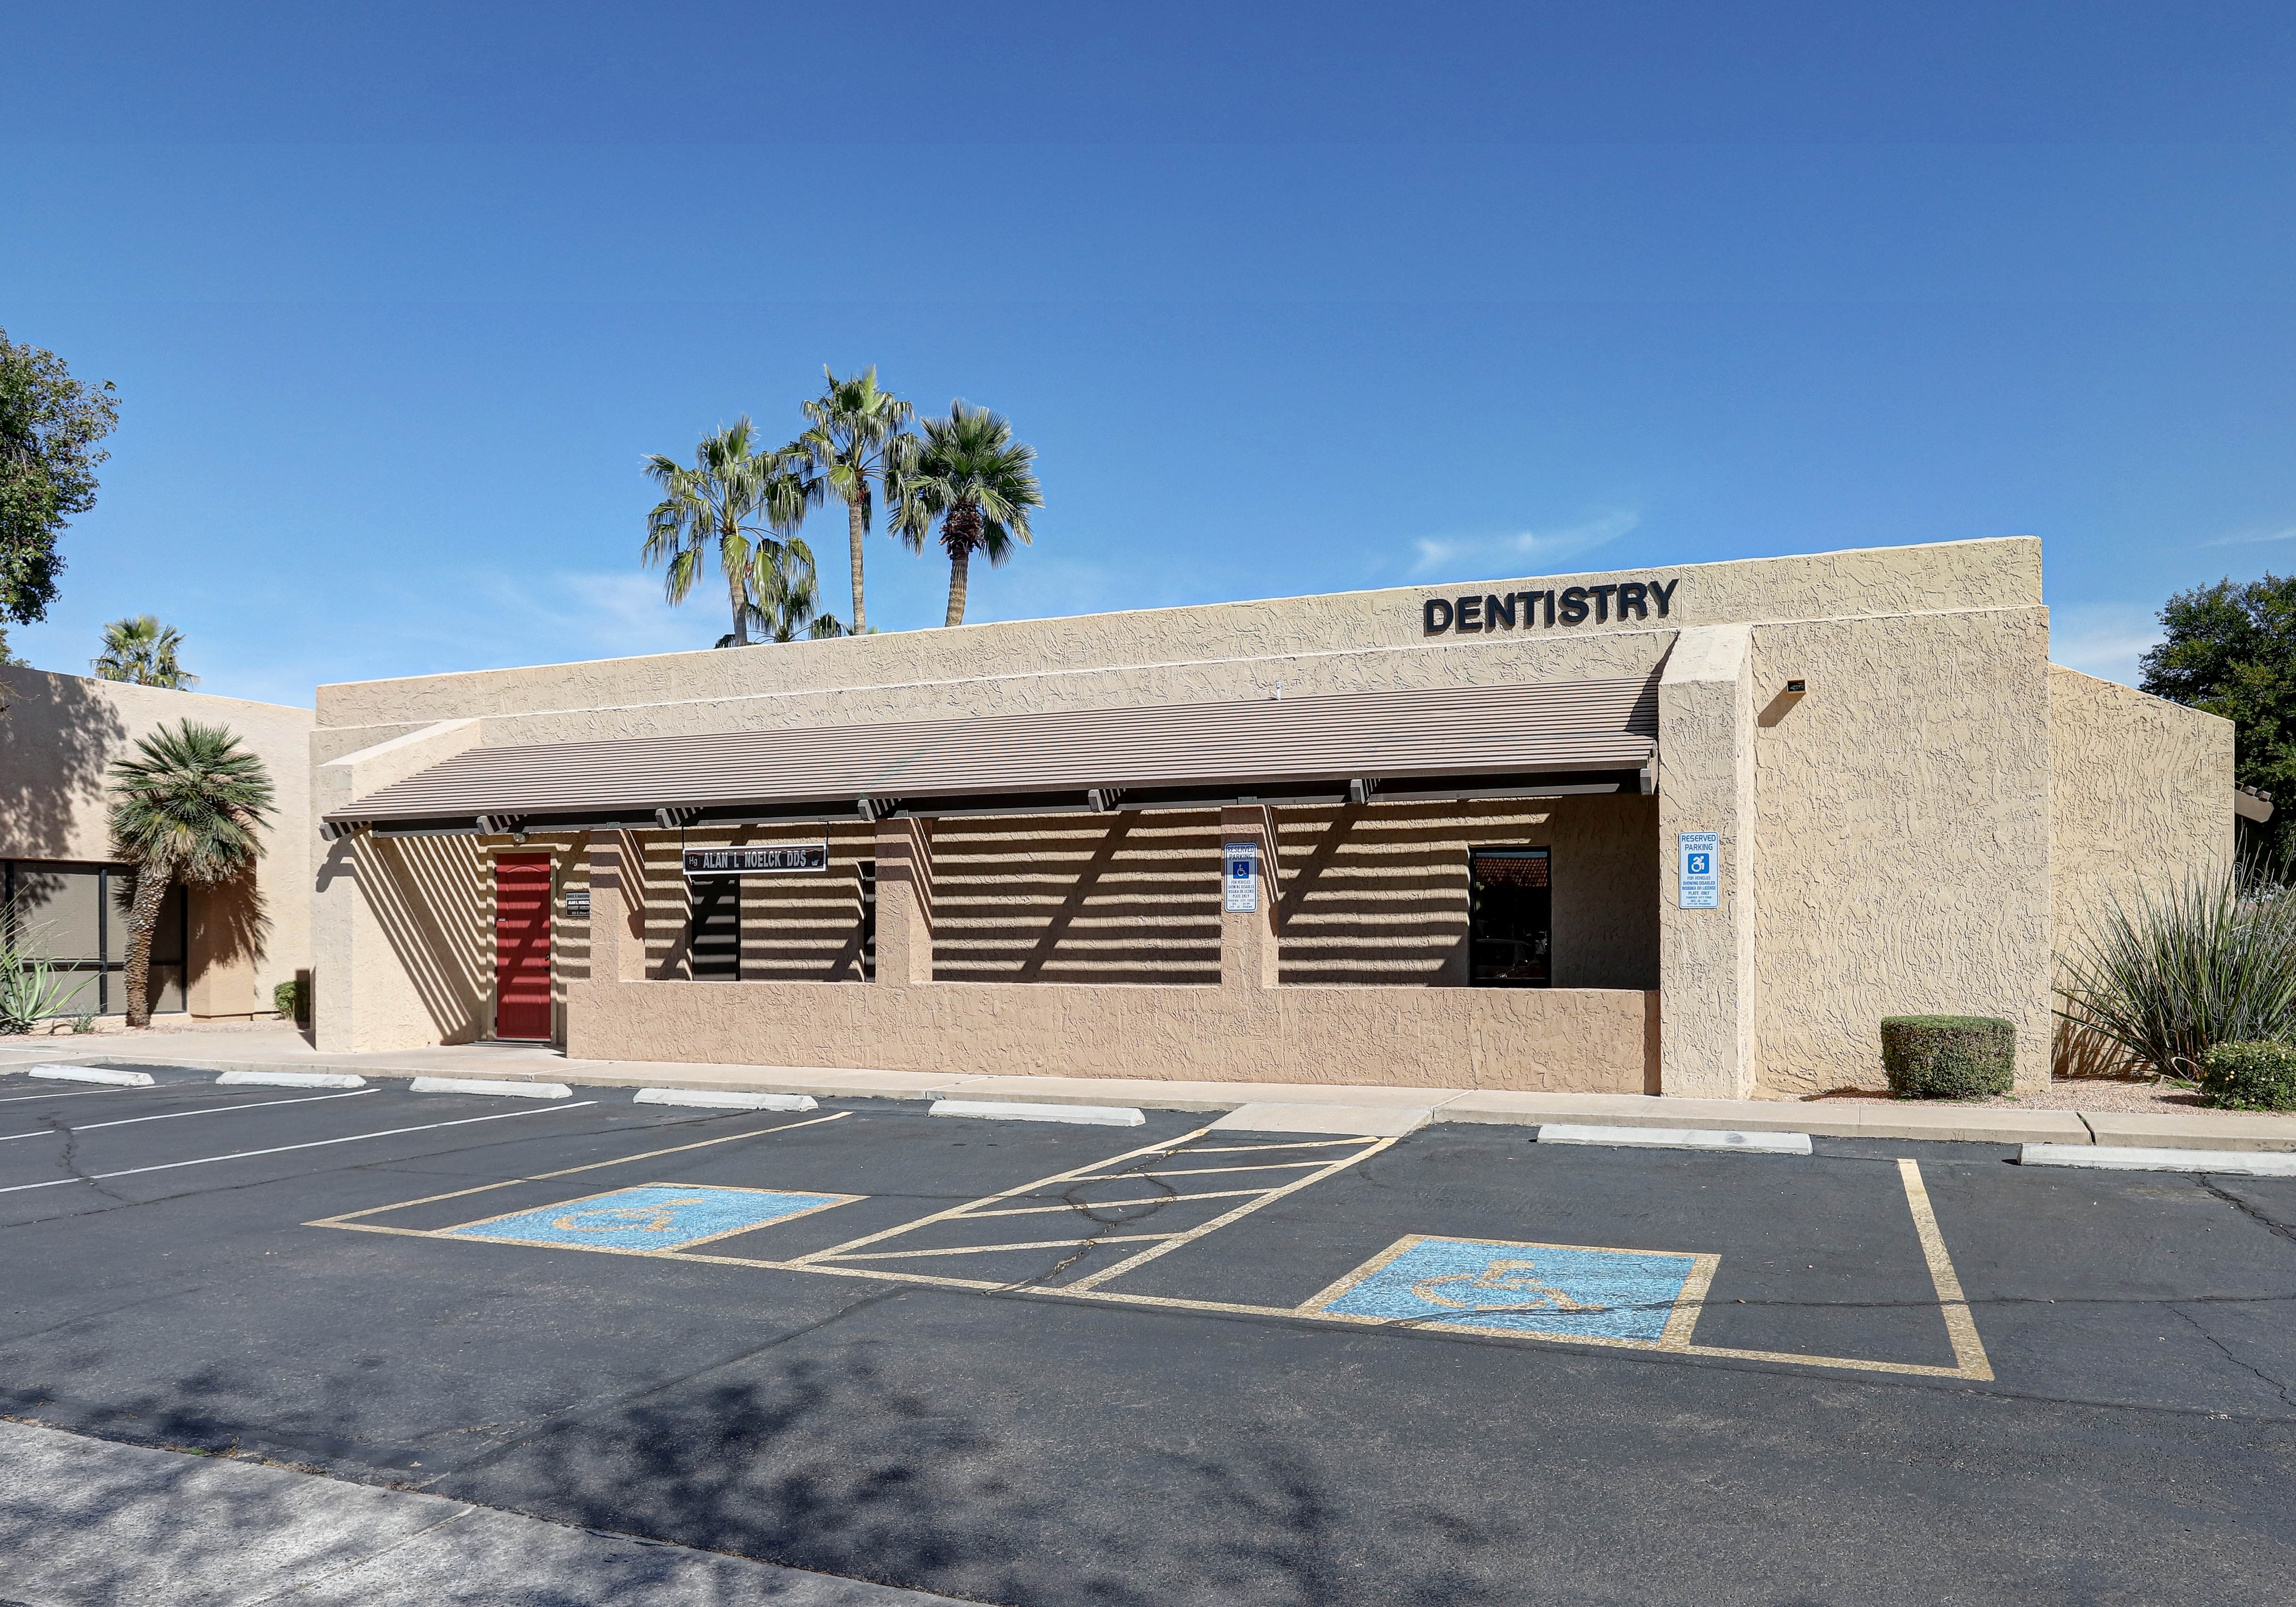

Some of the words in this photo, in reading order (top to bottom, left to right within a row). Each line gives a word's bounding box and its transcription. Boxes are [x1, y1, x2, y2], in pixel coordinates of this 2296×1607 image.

[1425, 578, 1680, 633] DENTISTRY
[703, 852, 728, 868] ALAN
[733, 852, 740, 868] L
[744, 850, 782, 868] NOELCK
[787, 850, 807, 867] DDS
